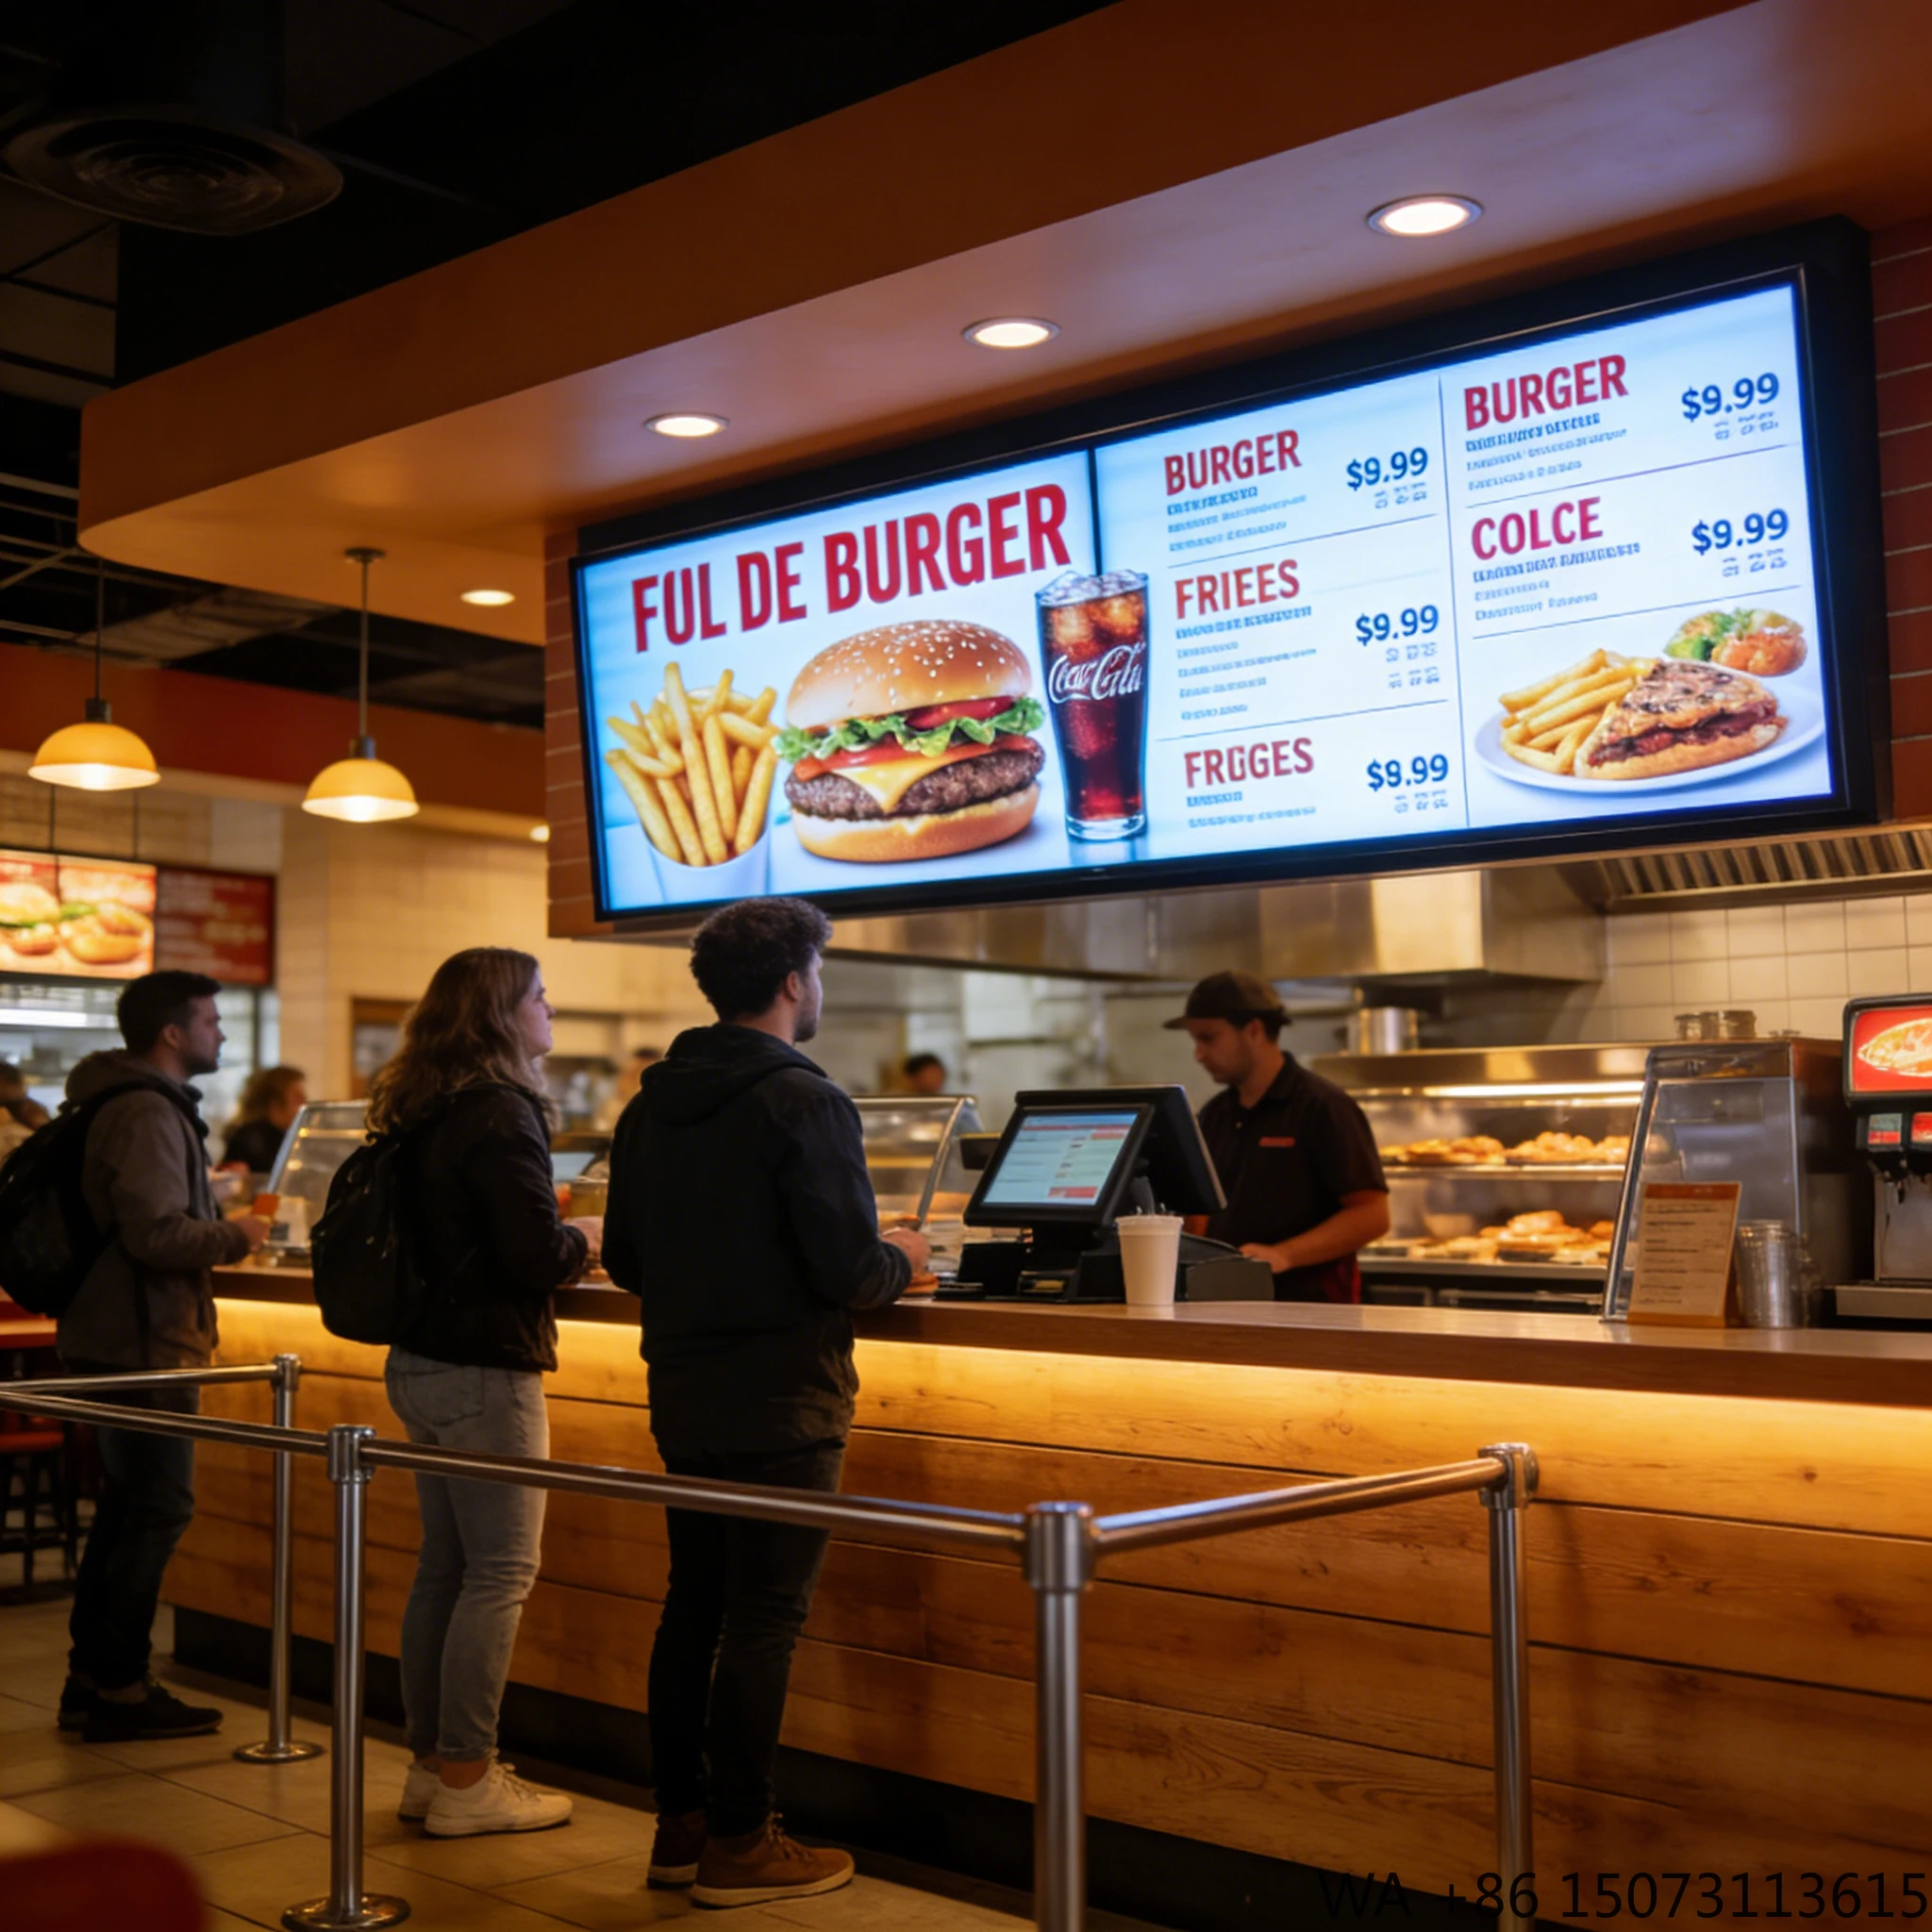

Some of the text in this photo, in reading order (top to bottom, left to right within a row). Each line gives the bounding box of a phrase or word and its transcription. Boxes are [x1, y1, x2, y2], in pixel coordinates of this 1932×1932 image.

[1464, 354, 1629, 431] BURGER
[1681, 372, 1780, 422] $9.99
[1165, 429, 1302, 496] BURGER
[1345, 446, 1429, 491] $9.99
[1472, 497, 1603, 561] COLCE
[1691, 508, 1790, 556] $9.99
[632, 563, 727, 653] FUL
[736, 541, 808, 633] DE
[824, 484, 1072, 613] BURGER
[1175, 558, 1301, 619] FRIEES
[1356, 605, 1440, 646] $9.99
